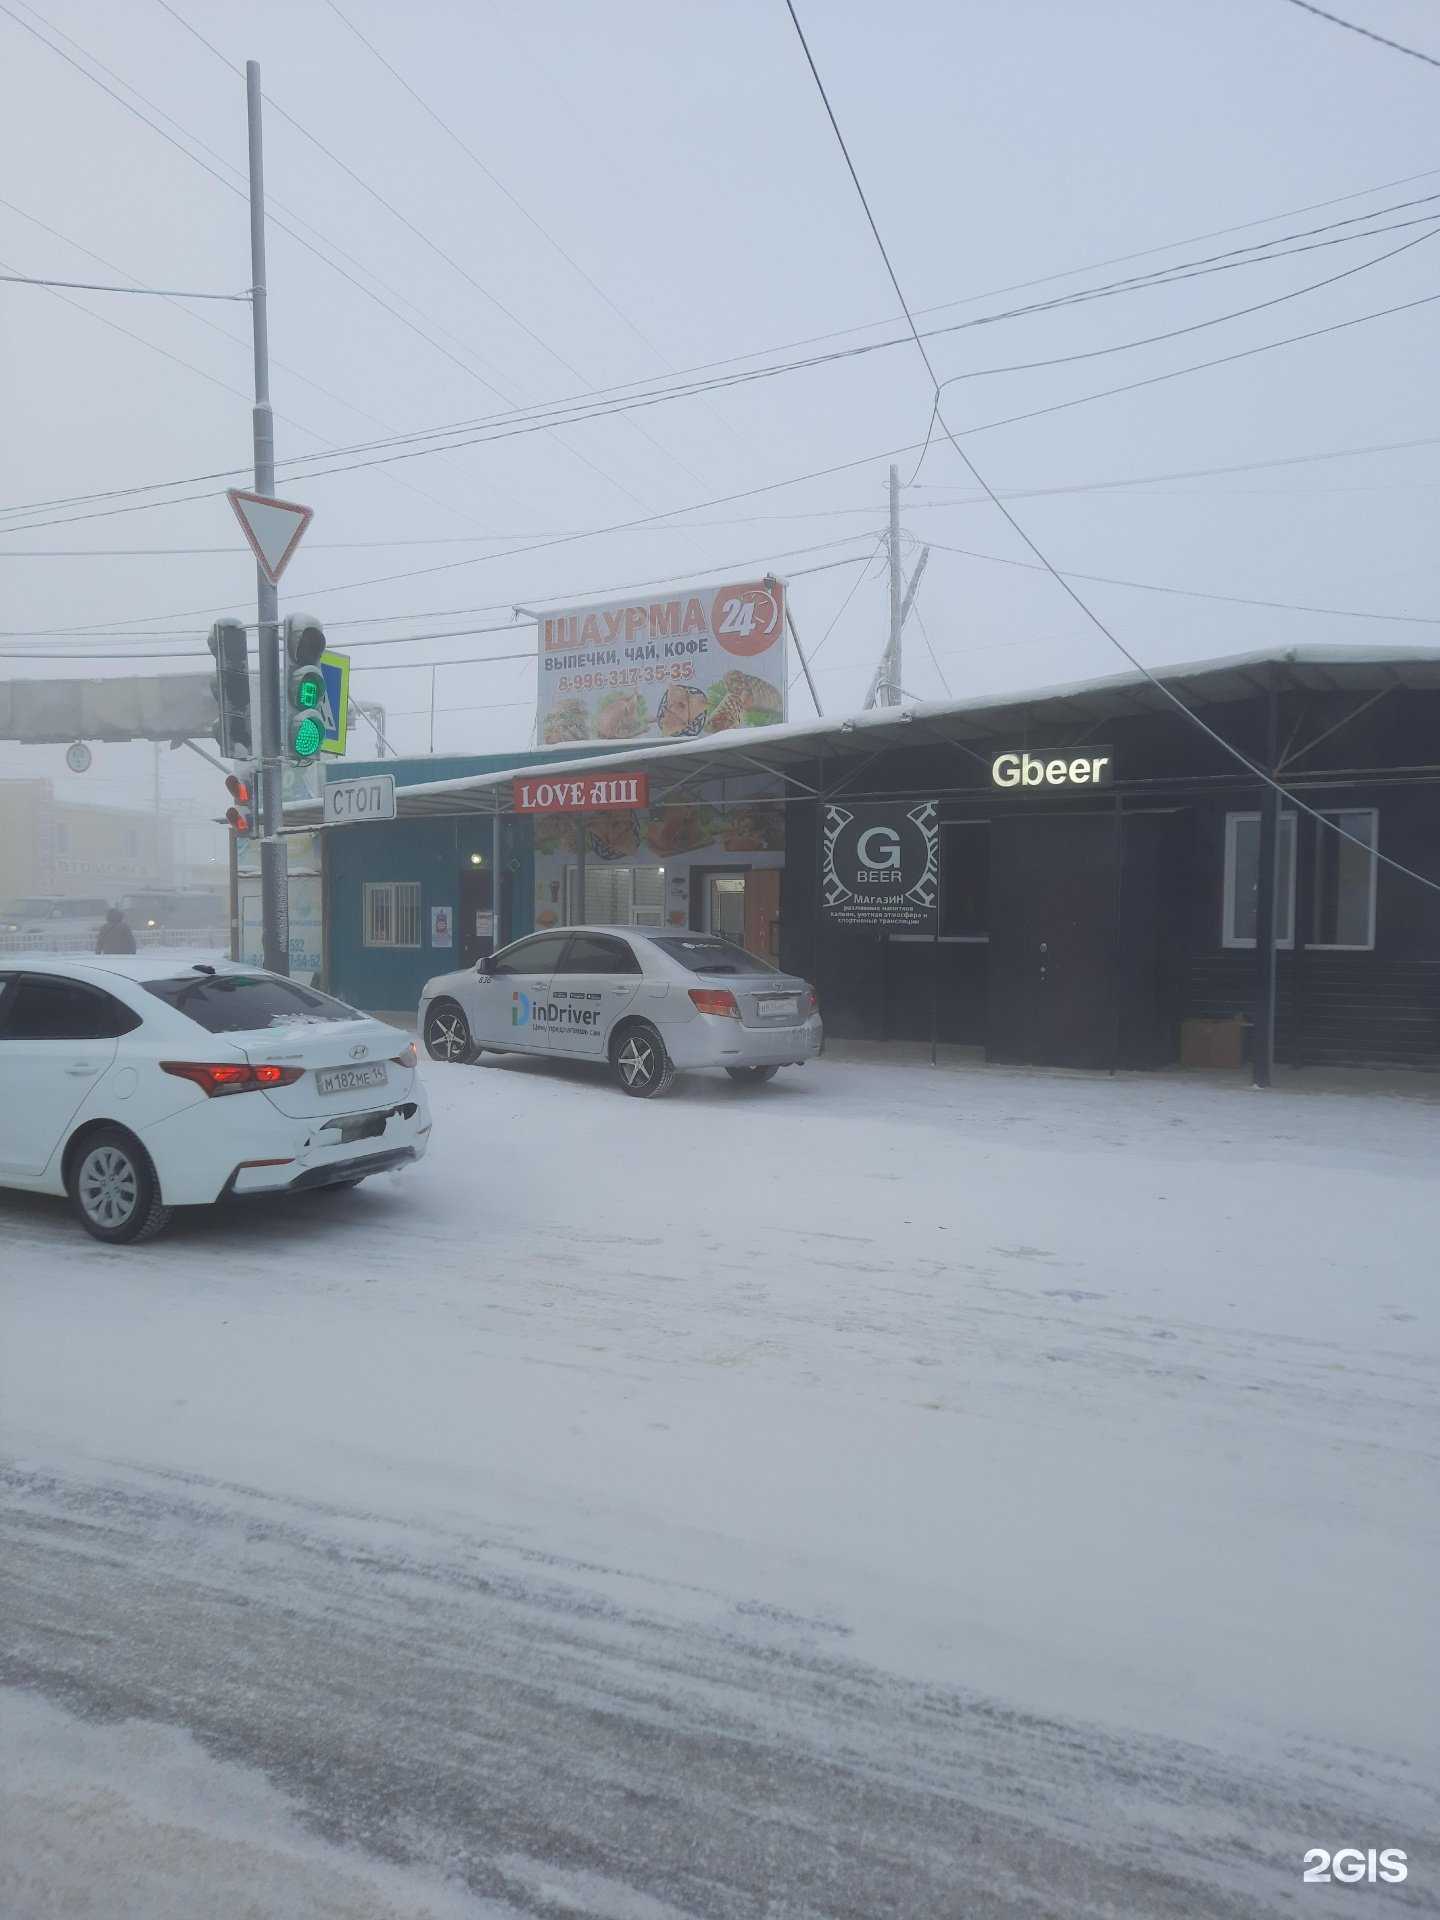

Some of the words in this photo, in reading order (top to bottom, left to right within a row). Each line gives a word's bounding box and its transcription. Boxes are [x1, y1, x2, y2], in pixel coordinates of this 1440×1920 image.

[544, 598, 709, 651] ШАУРМА
[718, 598, 756, 637] 24
[544, 649, 620, 671] ВЫПЕЧКИ,
[624, 641, 659, 660] ЧАЙ,
[664, 638, 708, 658] КОФЕ
[992, 753, 1109, 788] Gbeer
[332, 785, 382, 816] СТОП
[521, 784, 586, 808] LOVE
[857, 826, 901, 869] G
[857, 870, 902, 883] BEER
[533, 1001, 601, 1026] inDriver
